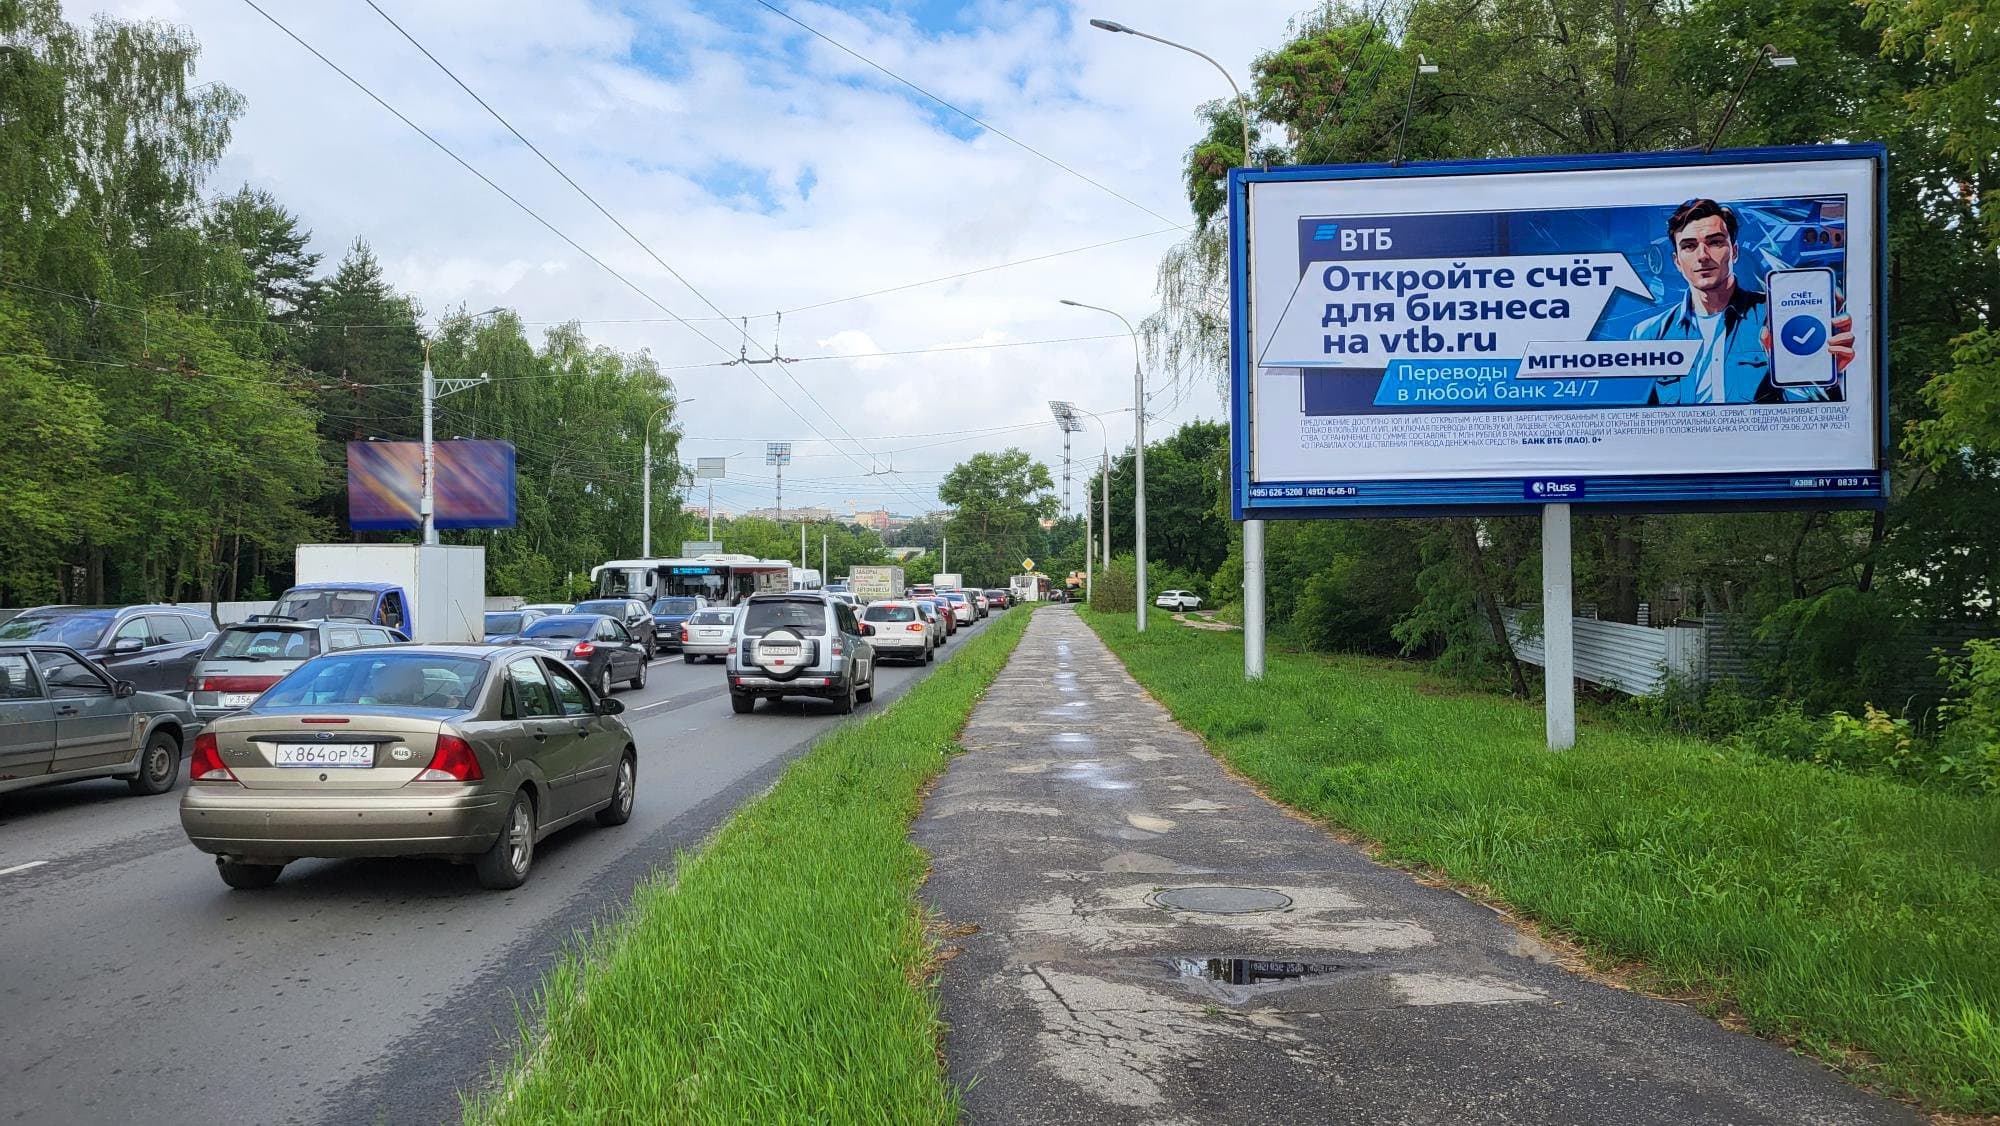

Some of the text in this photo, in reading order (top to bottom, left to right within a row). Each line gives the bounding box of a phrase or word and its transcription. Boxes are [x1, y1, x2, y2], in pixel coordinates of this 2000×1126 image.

[1341, 228, 1392, 251] ВТБ
[1323, 259, 1613, 297] Откройте счёт
[1781, 298, 1822, 306] ОПЛАЧЕН
[1791, 290, 1812, 299] СЧЁТ
[1322, 292, 1570, 328] для бизнеса
[1324, 326, 1497, 354] на vtb.ru
[1528, 350, 1684, 369] мгновенно
[1399, 365, 1507, 384] Переводы
[1398, 380, 1600, 400] в любой банк 24/7
[1749, 407, 1818, 416] ПРЕДУСМАТРИВАЕТ
[1408, 432, 1451, 440] СОСТАВЛЯЕТ
[1475, 430, 1500, 438] РУБЛЕЙ
[1540, 429, 1565, 437] ОДНОЙ
[1666, 425, 1712, 433] ПОЛОЖЕНИИ
[1738, 424, 1768, 432] РОССИИ
[1781, 423, 1818, 431] 29.06.2021
[1431, 423, 1468, 431] ПЕРЕВОДЫ
[1474, 423, 1500, 431] ПОЛЬЗУ
[1647, 417, 1717, 427] ТЕРРИТОРИАЛЬНЫХ
[1751, 415, 1807, 424] ФЕДЕРАЛЬНОГО
[1250, 488, 1268, 496] (495)
[1546, 482, 1576, 492] Russ
[284, 746, 368, 762] Х864ОР 62
